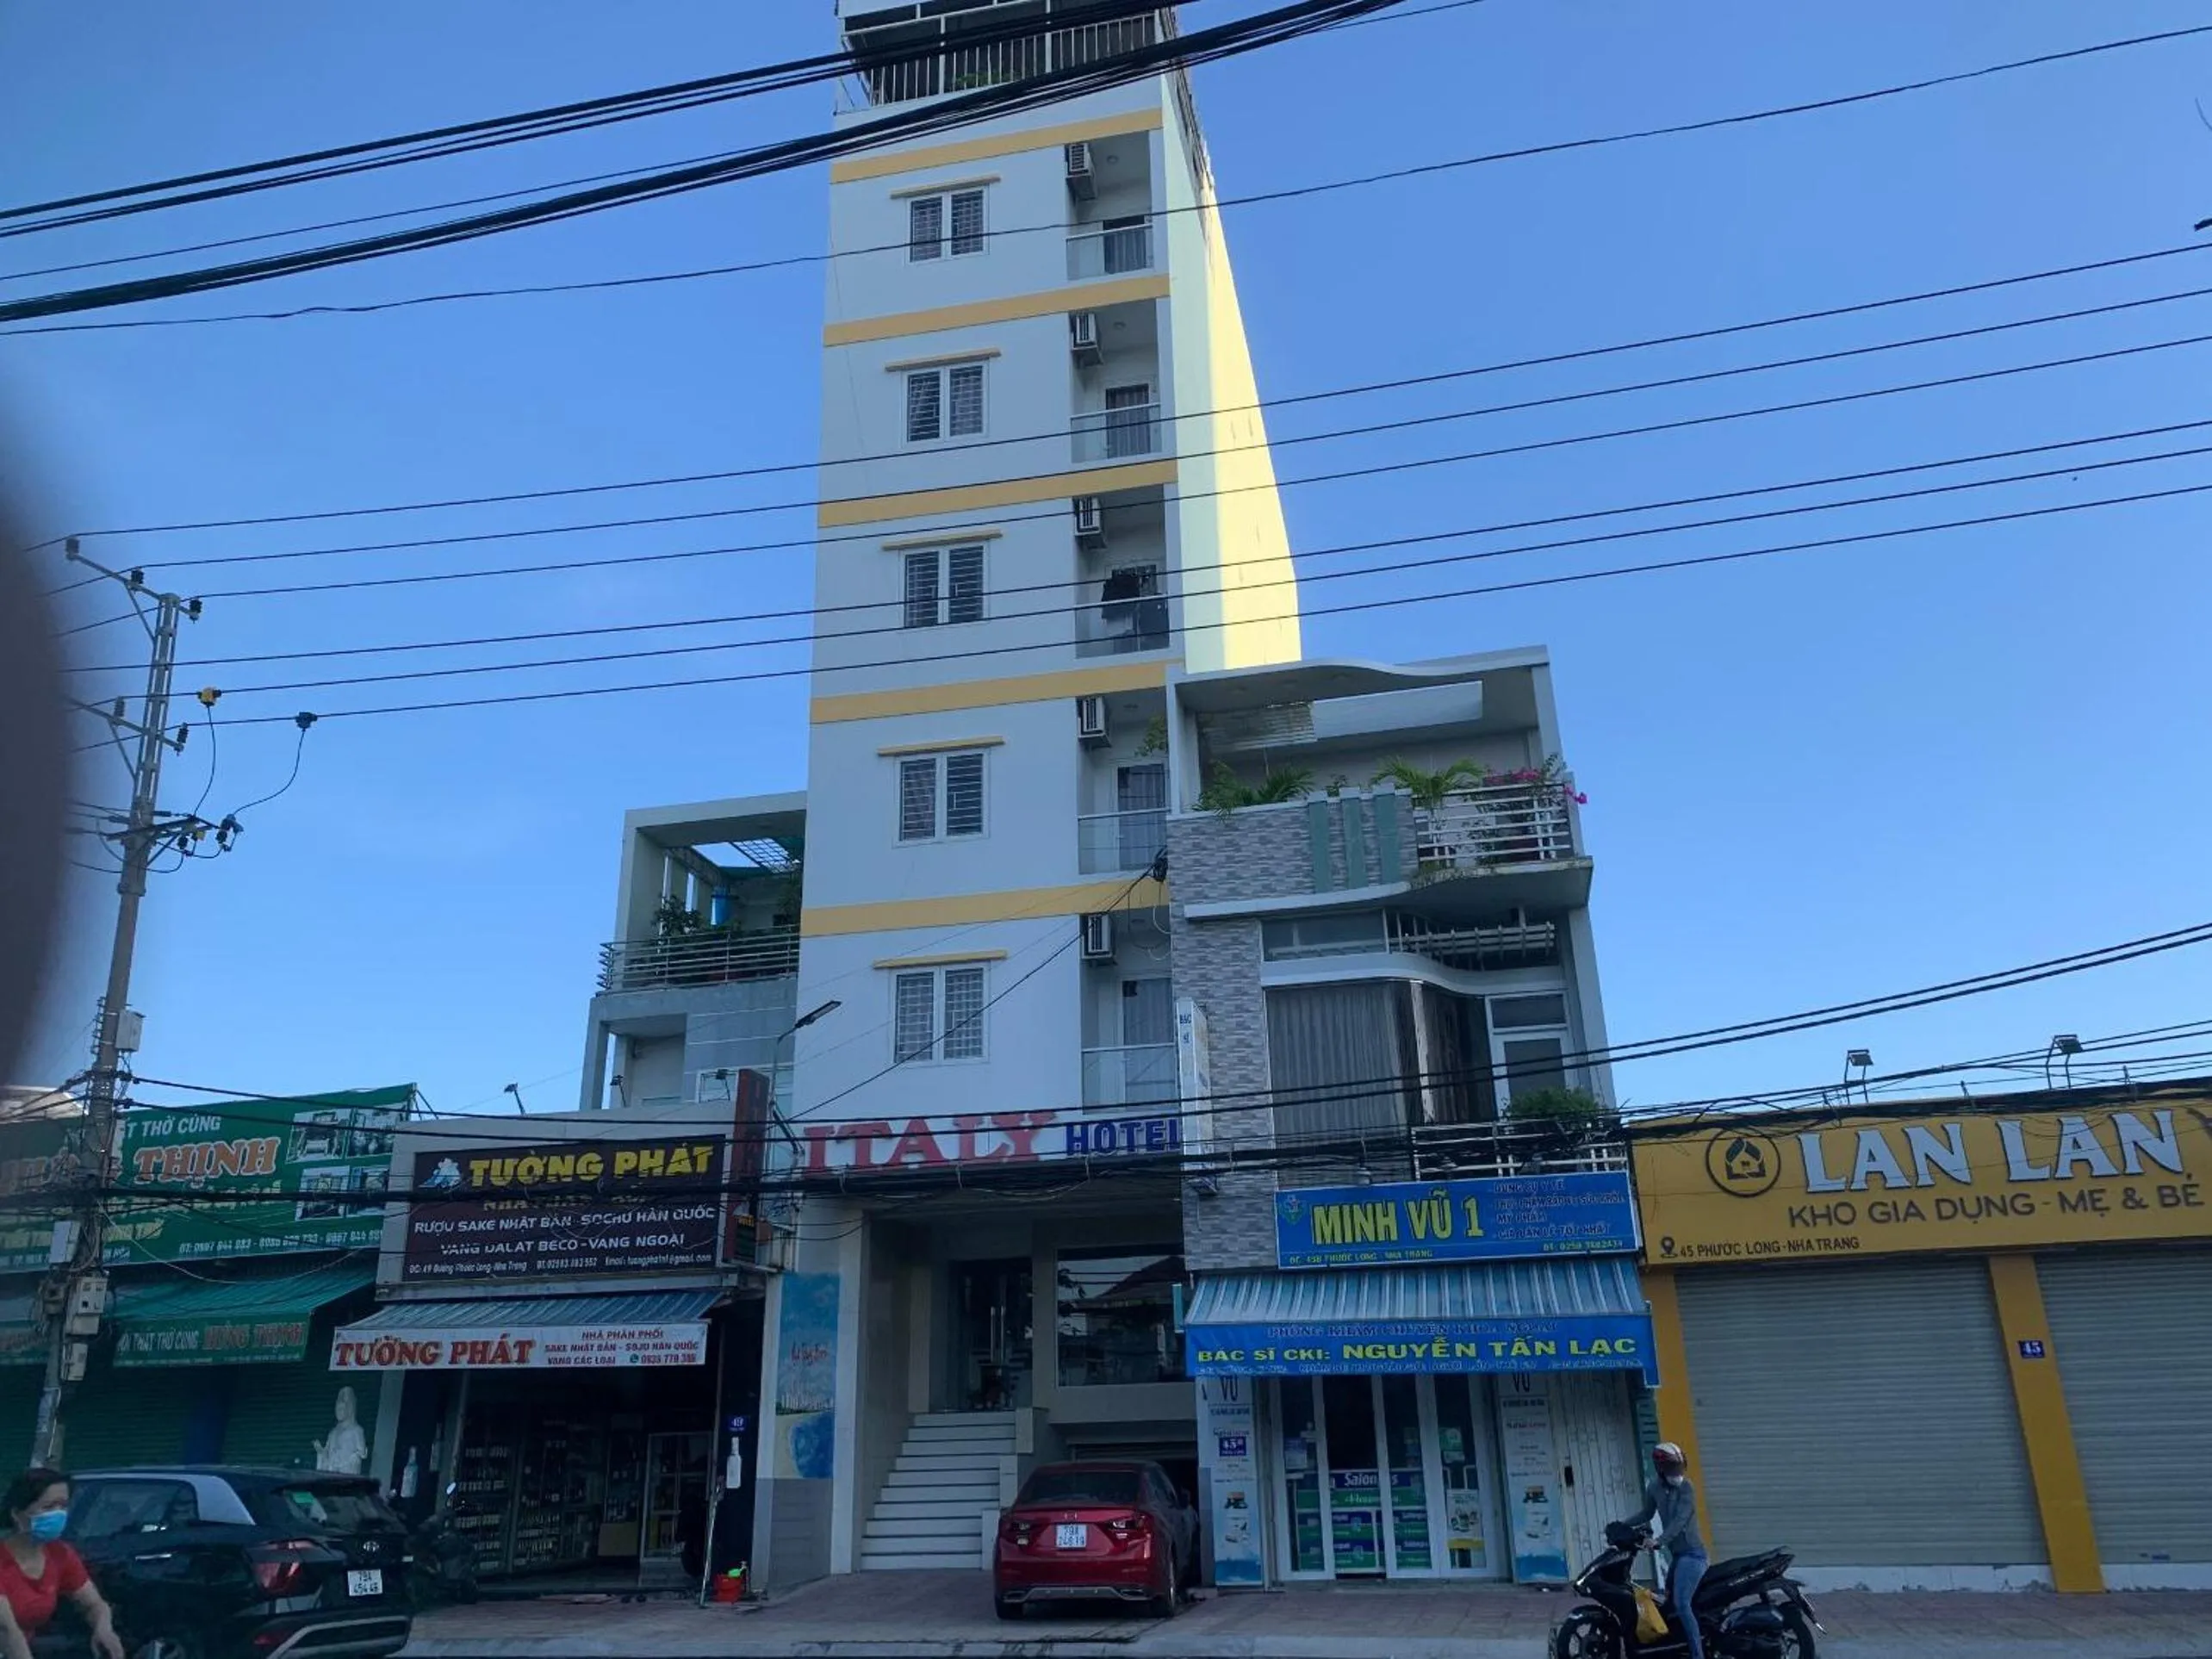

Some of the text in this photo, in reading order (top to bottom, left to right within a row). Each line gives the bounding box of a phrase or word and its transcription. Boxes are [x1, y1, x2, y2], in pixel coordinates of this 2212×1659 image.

[141, 1115, 177, 1136] THỜ
[178, 1114, 221, 1134] CÚNG
[804, 1109, 1055, 1177] ITALY
[1066, 1119, 1181, 1156] HOTEL
[134, 1137, 281, 1190] THỊNH
[469, 1142, 714, 1187] TƯỜNG PHÁT
[1798, 1109, 2185, 1194] LAN LAN
[1312, 1189, 1484, 1246] MINH VŨ 1
[1789, 1204, 1857, 1228] KHO
[1867, 1198, 1927, 1224] GIA
[1936, 1193, 2035, 1225] DỤNG
[2058, 1188, 2110, 1218] MẸ
[2122, 1186, 2149, 1210] &
[2160, 1173, 2206, 1208] BÉ
[458, 1219, 495, 1233] SAKE
[500, 1216, 536, 1233] NHẬT
[538, 1239, 579, 1252] BECO
[636, 1234, 684, 1251] NGOẠI
[1681, 1246, 1693, 1258] 45
[1817, 1237, 1860, 1250] TRANG
[335, 1333, 535, 1367] TƯỜNG PHÁT
[1342, 1337, 1476, 1359] NGUYỄN
[1488, 1335, 1556, 1358] TẤN
[1569, 1339, 1637, 1358] LẠC
